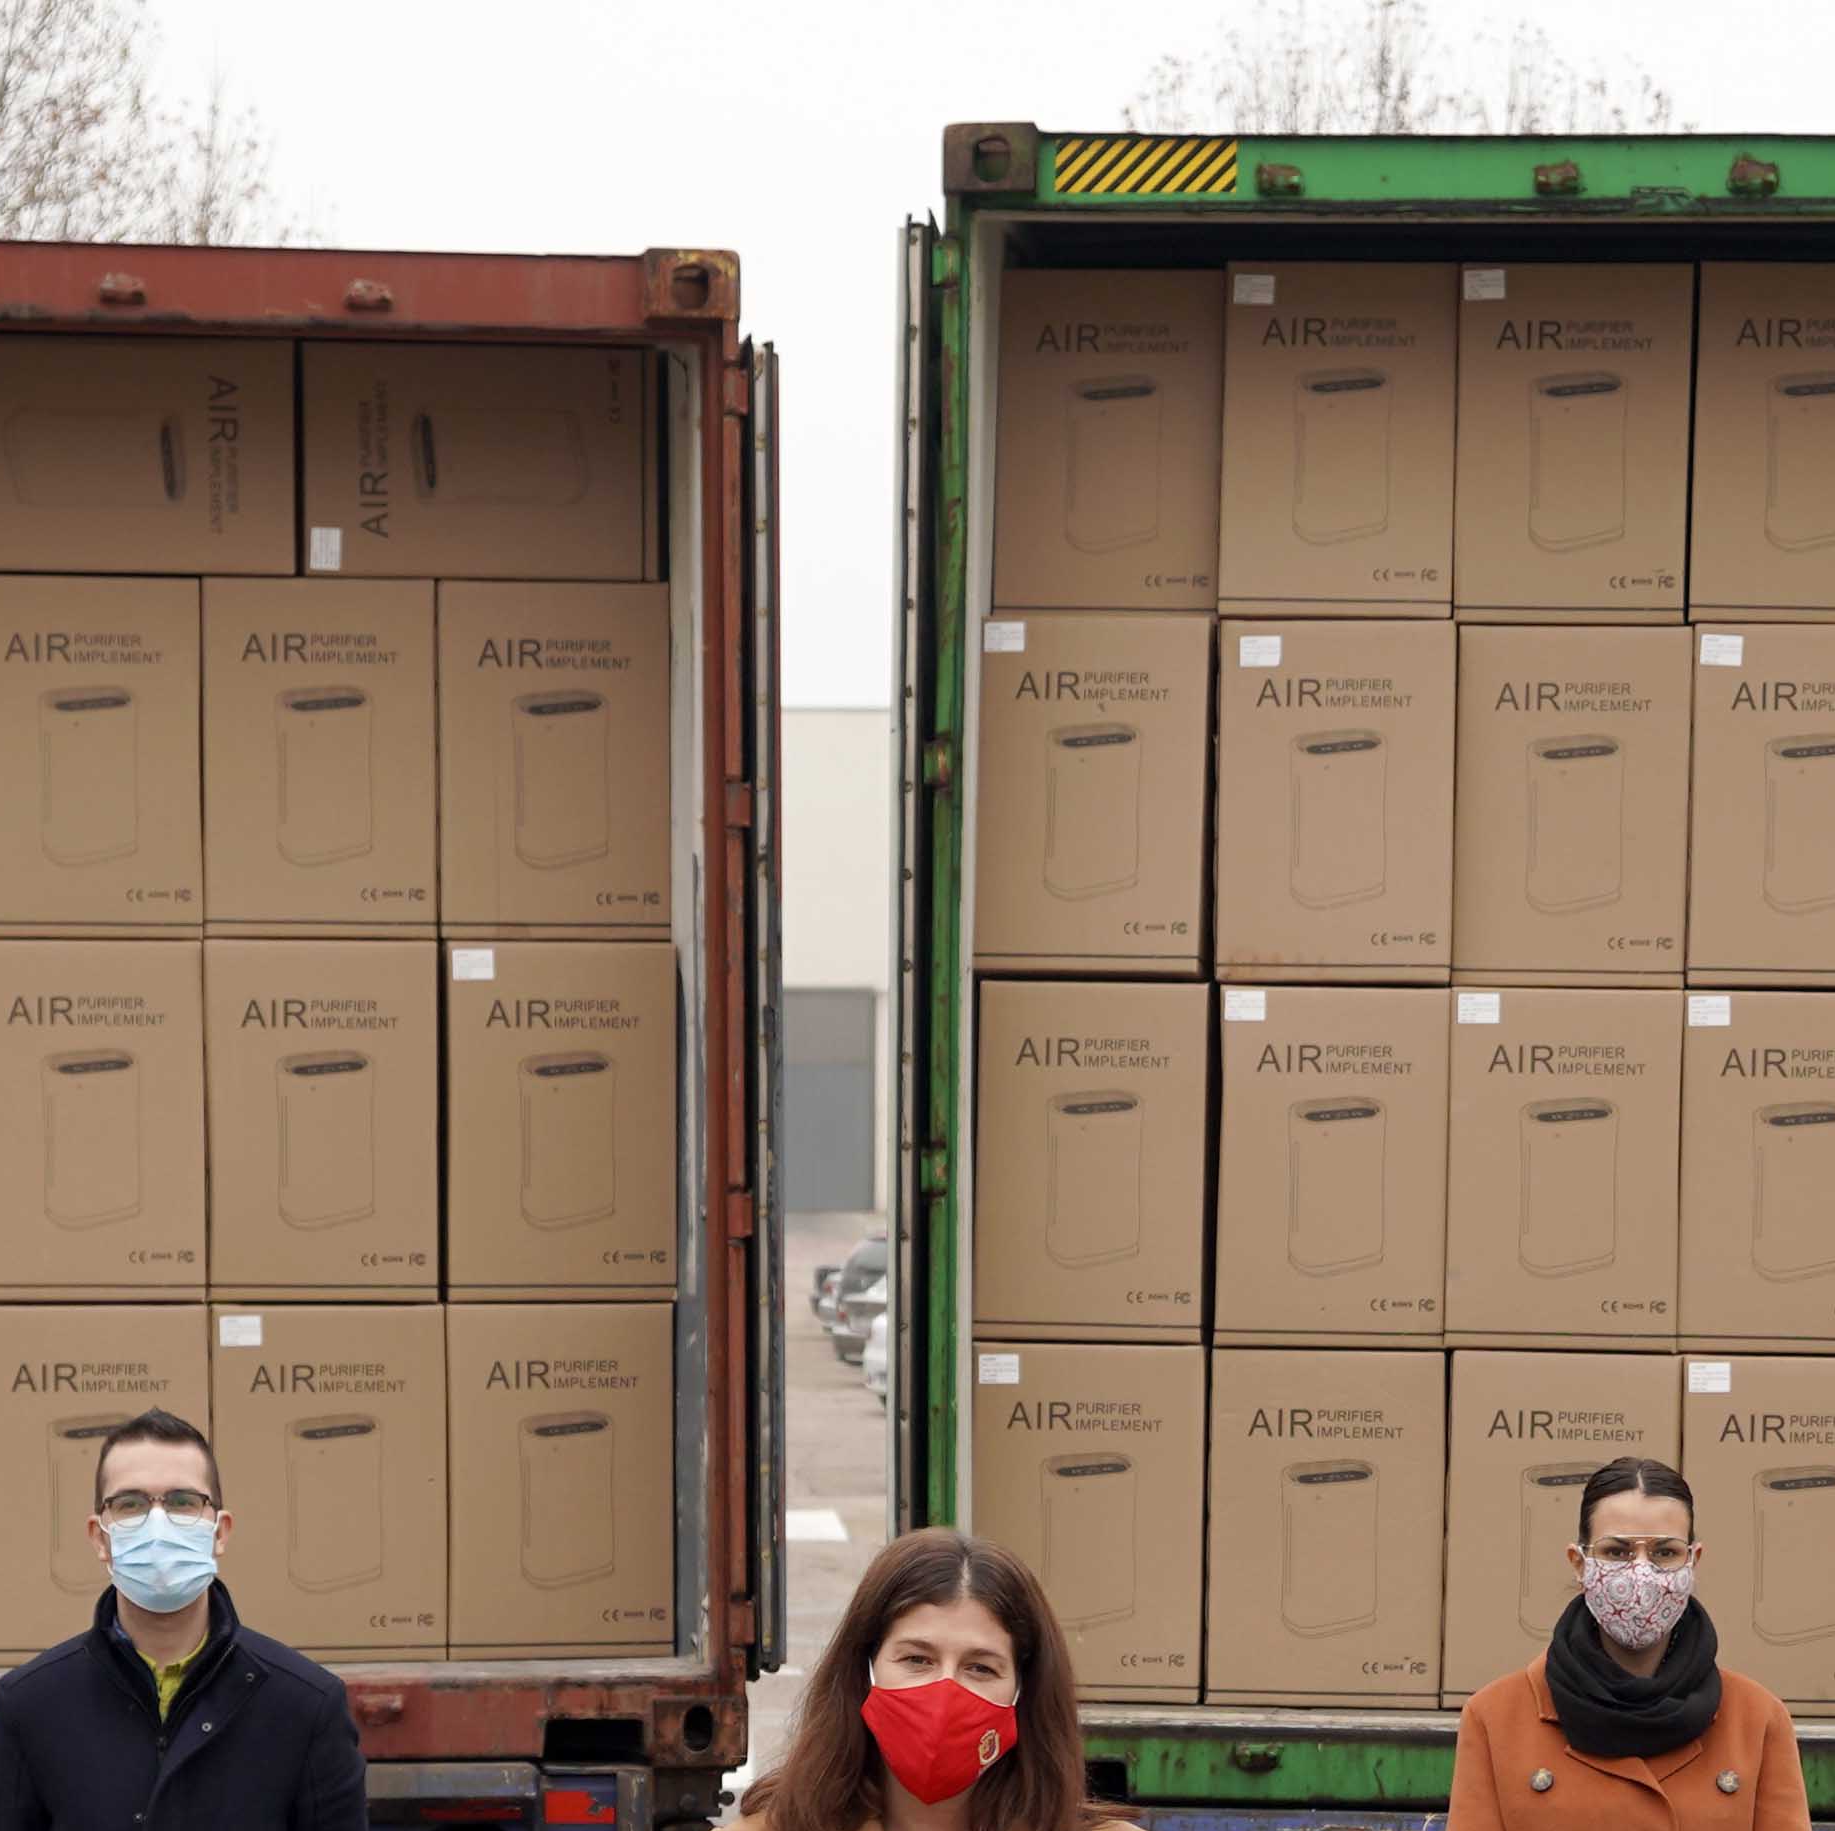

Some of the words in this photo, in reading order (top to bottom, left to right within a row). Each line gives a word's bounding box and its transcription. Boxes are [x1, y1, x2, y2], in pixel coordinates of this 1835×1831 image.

[1036, 323, 1101, 353] AIR
[1262, 317, 1327, 347] AIR
[1496, 320, 1563, 350] AIR
[1735, 318, 1803, 348] AIR
[208, 376, 237, 443] AIR
[360, 471, 389, 538] AIR
[4, 633, 72, 663] AIR
[241, 633, 308, 663] AIR
[478, 638, 543, 668] AIR
[1015, 671, 1080, 700] AIR
[1083, 671, 1149, 685] PURIFIER
[1083, 687, 1169, 705] IMPLEMENT
[1256, 678, 1322, 708] AIR
[1325, 678, 1393, 692] PURIFIER
[1495, 682, 1561, 711] AIR
[1564, 682, 1635, 697] PURIFIER
[1731, 682, 1798, 711] AIR
[1324, 694, 1412, 708] IMPLEMENT
[1563, 698, 1652, 712] IMPLEMENT
[7, 996, 74, 1026] AIR
[241, 999, 308, 1028] AIR
[486, 999, 552, 1029] AIR
[1015, 1037, 1081, 1067] AIR
[1084, 1038, 1150, 1052] PURIFIER
[1083, 1054, 1170, 1069] IMPLEMENT
[1257, 1044, 1323, 1073] AIR
[1326, 1044, 1393, 1060] PURIFIER
[1488, 1045, 1554, 1074] AIR
[1558, 1045, 1625, 1060] PURIFIER
[1721, 1048, 1788, 1078] AIR
[1325, 1059, 1412, 1075] IMPLEMENT
[1557, 1061, 1646, 1076] IMPLEMENT
[12, 1363, 79, 1392] AIR
[81, 1363, 149, 1377] PURIFIER
[80, 1379, 170, 1393] IMPLEMENT
[250, 1364, 316, 1393] AIR
[318, 1363, 385, 1378] PURIFIER
[317, 1379, 406, 1393] IMPLEMENT
[486, 1360, 551, 1390] AIR
[553, 1360, 619, 1375] PURIFIER
[553, 1375, 638, 1389] IMPLEMENT
[1007, 1401, 1073, 1430] AIR
[1076, 1401, 1142, 1417] PURIFIER
[1075, 1416, 1162, 1432] IMPLEMENT
[1248, 1408, 1314, 1438] AIR
[1317, 1409, 1383, 1424] PURIFIER
[1487, 1410, 1554, 1439] AIR
[1557, 1411, 1625, 1426] PURIFIER
[1720, 1414, 1786, 1443] AIR
[1316, 1423, 1403, 1439] IMPLEMENT
[1557, 1427, 1644, 1442] IMPLEMENT
